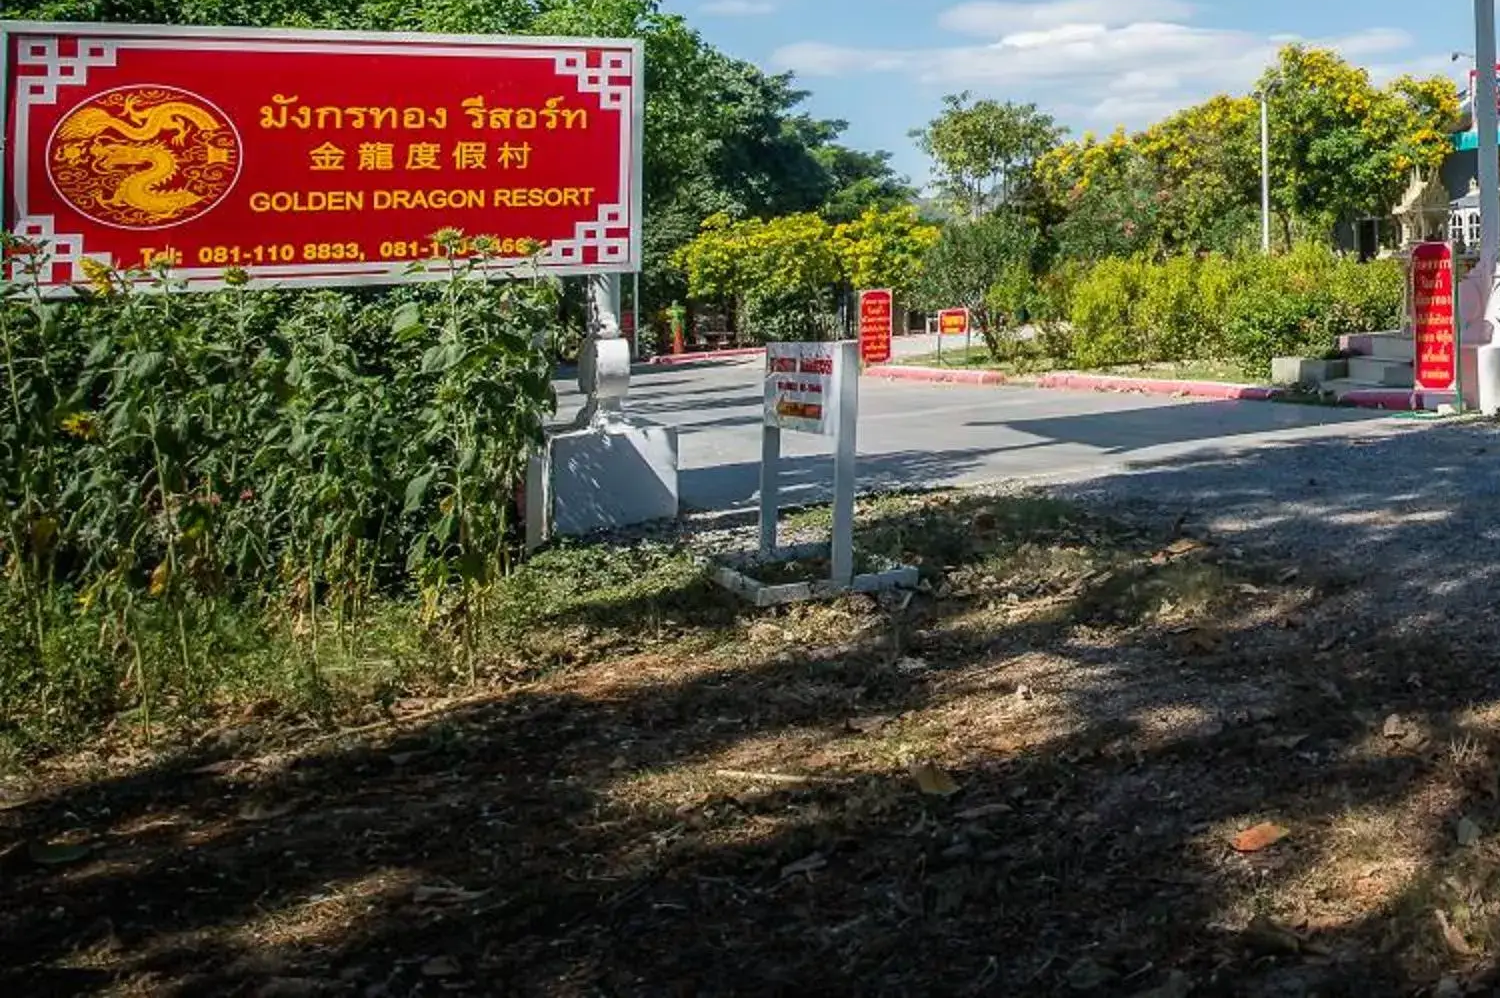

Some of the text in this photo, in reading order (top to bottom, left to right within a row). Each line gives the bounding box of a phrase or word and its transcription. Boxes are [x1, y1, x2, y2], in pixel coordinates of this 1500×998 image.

[259, 93, 588, 129] มังกรทอง รีสอร์ท
[309, 141, 532, 171] 金龍度假村
[249, 187, 595, 212] GOLDEN DRAGON RESORT
[199, 244, 295, 263] 081-110
[303, 242, 365, 262] 8833,
